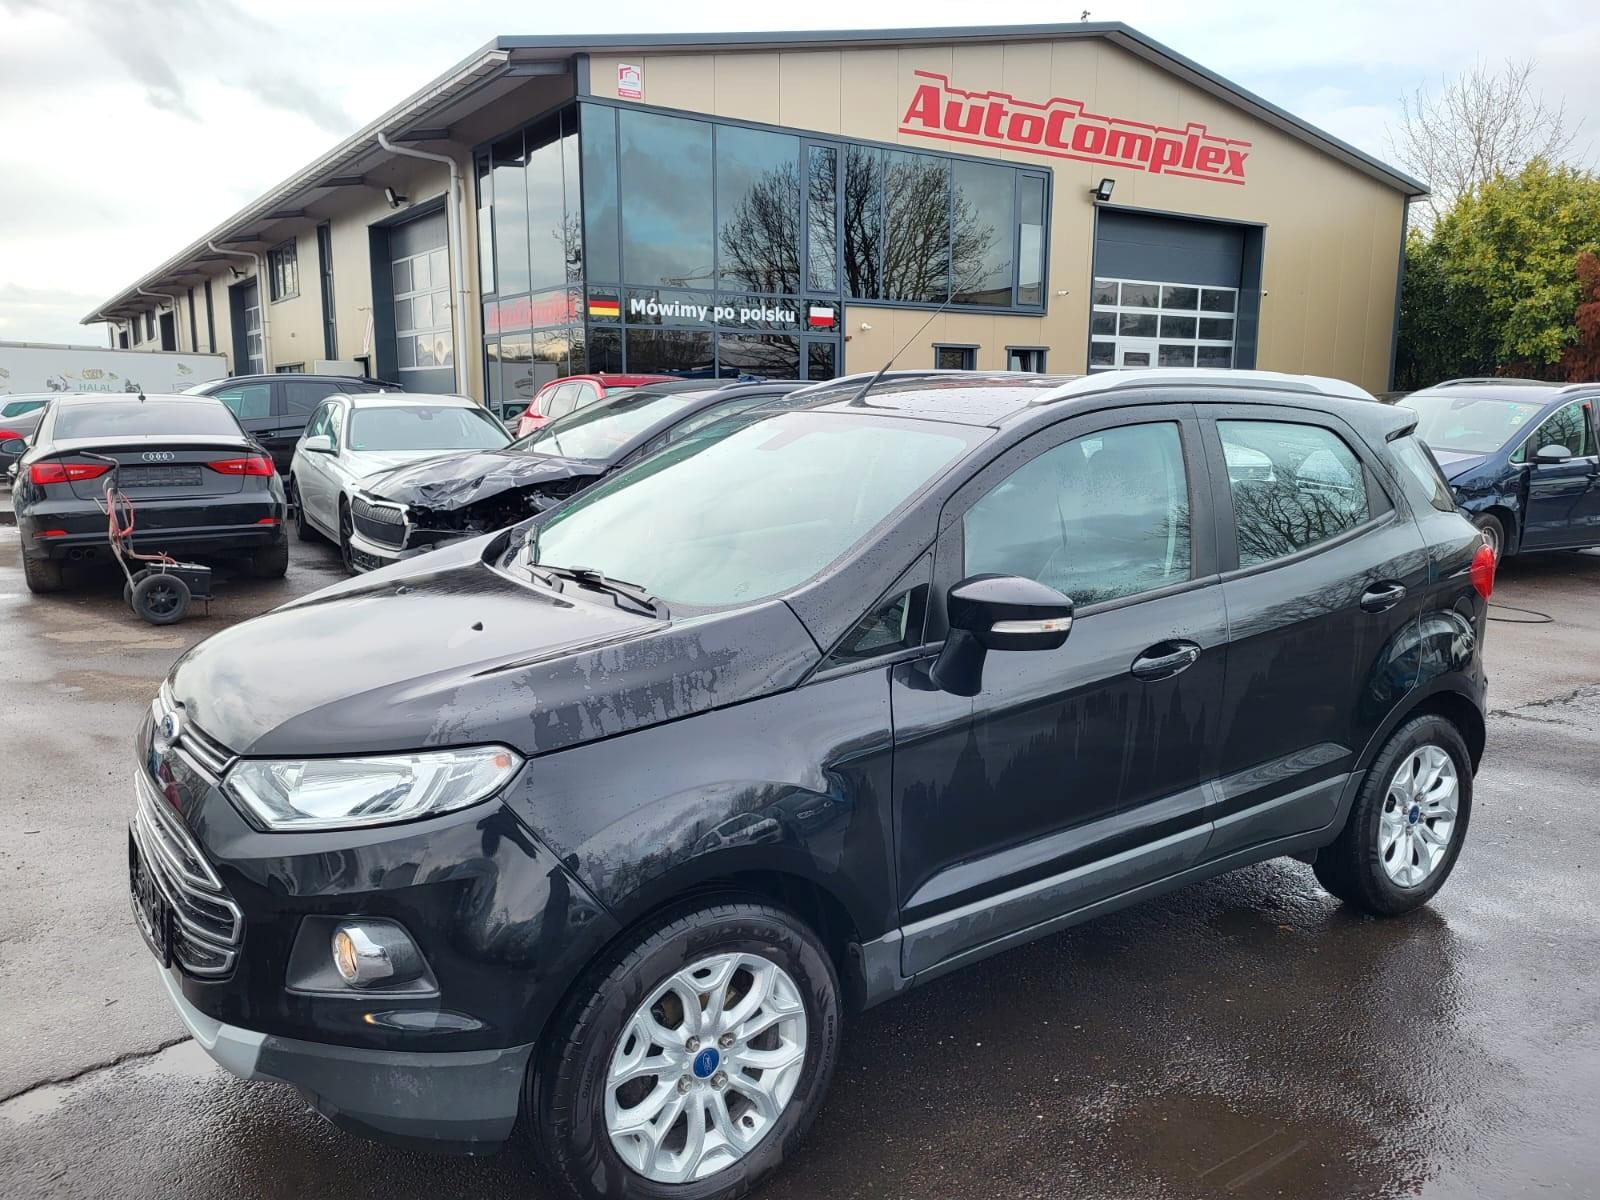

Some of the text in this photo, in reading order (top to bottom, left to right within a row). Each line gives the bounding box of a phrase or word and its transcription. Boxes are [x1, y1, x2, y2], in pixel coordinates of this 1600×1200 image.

[903, 84, 1248, 174] AutoComplex
[630, 298, 796, 323] Mówimy po polsku
[79, 383, 113, 392] HALAL
